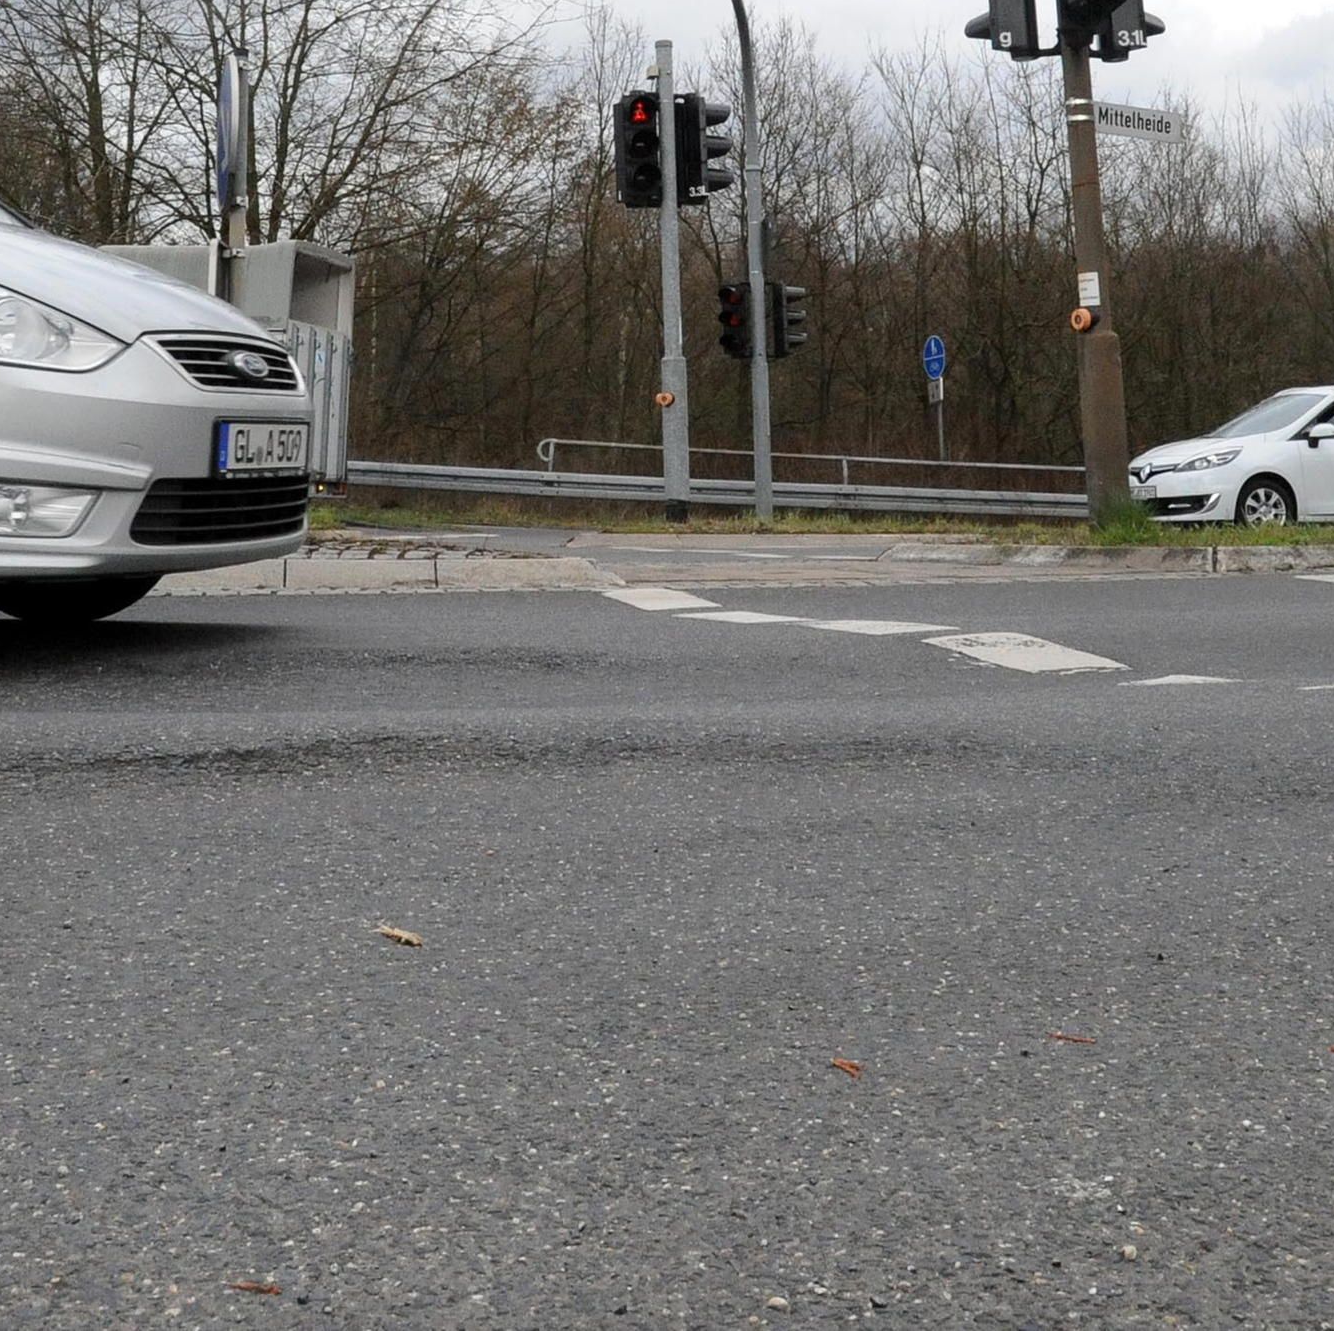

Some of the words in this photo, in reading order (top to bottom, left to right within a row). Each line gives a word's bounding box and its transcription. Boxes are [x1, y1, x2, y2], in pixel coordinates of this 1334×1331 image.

[1098, 107, 1172, 134] Mittelheide
[234, 429, 255, 463] GL
[265, 430, 274, 463] A
[277, 429, 302, 462] 509
